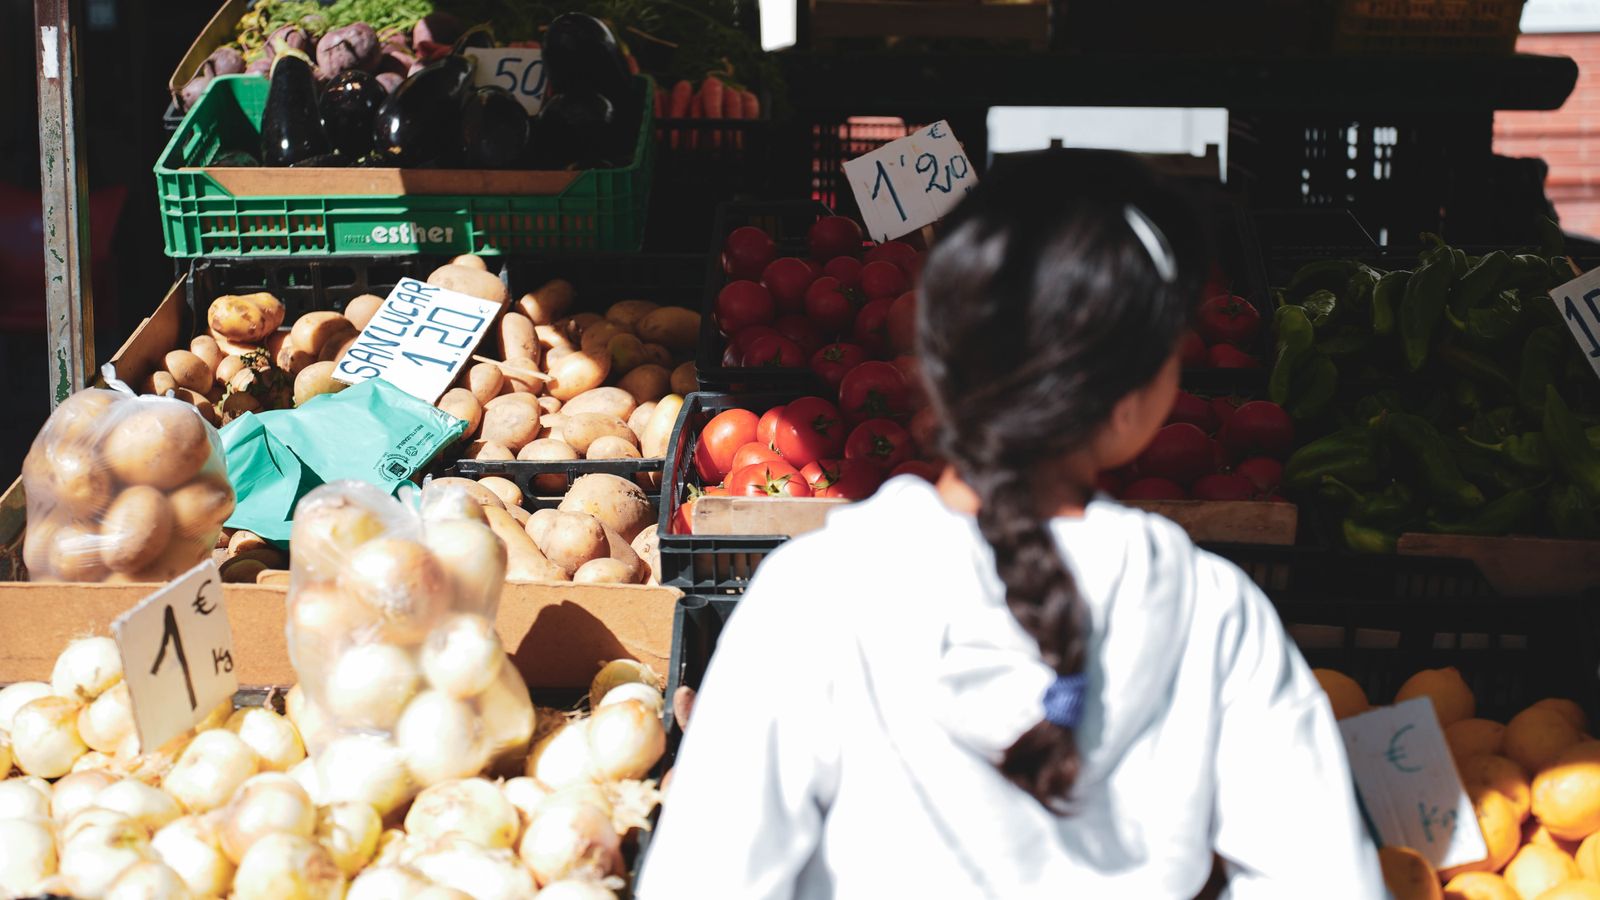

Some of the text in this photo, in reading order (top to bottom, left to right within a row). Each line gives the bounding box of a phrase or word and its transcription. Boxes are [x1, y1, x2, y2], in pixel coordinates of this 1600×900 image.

[371, 222, 454, 244] esther
[339, 281, 440, 379] SANLUCAR
[402, 306, 486, 373] 1.20
[191, 579, 217, 615] €
[150, 604, 197, 711] 1
[1384, 723, 1424, 773] €
